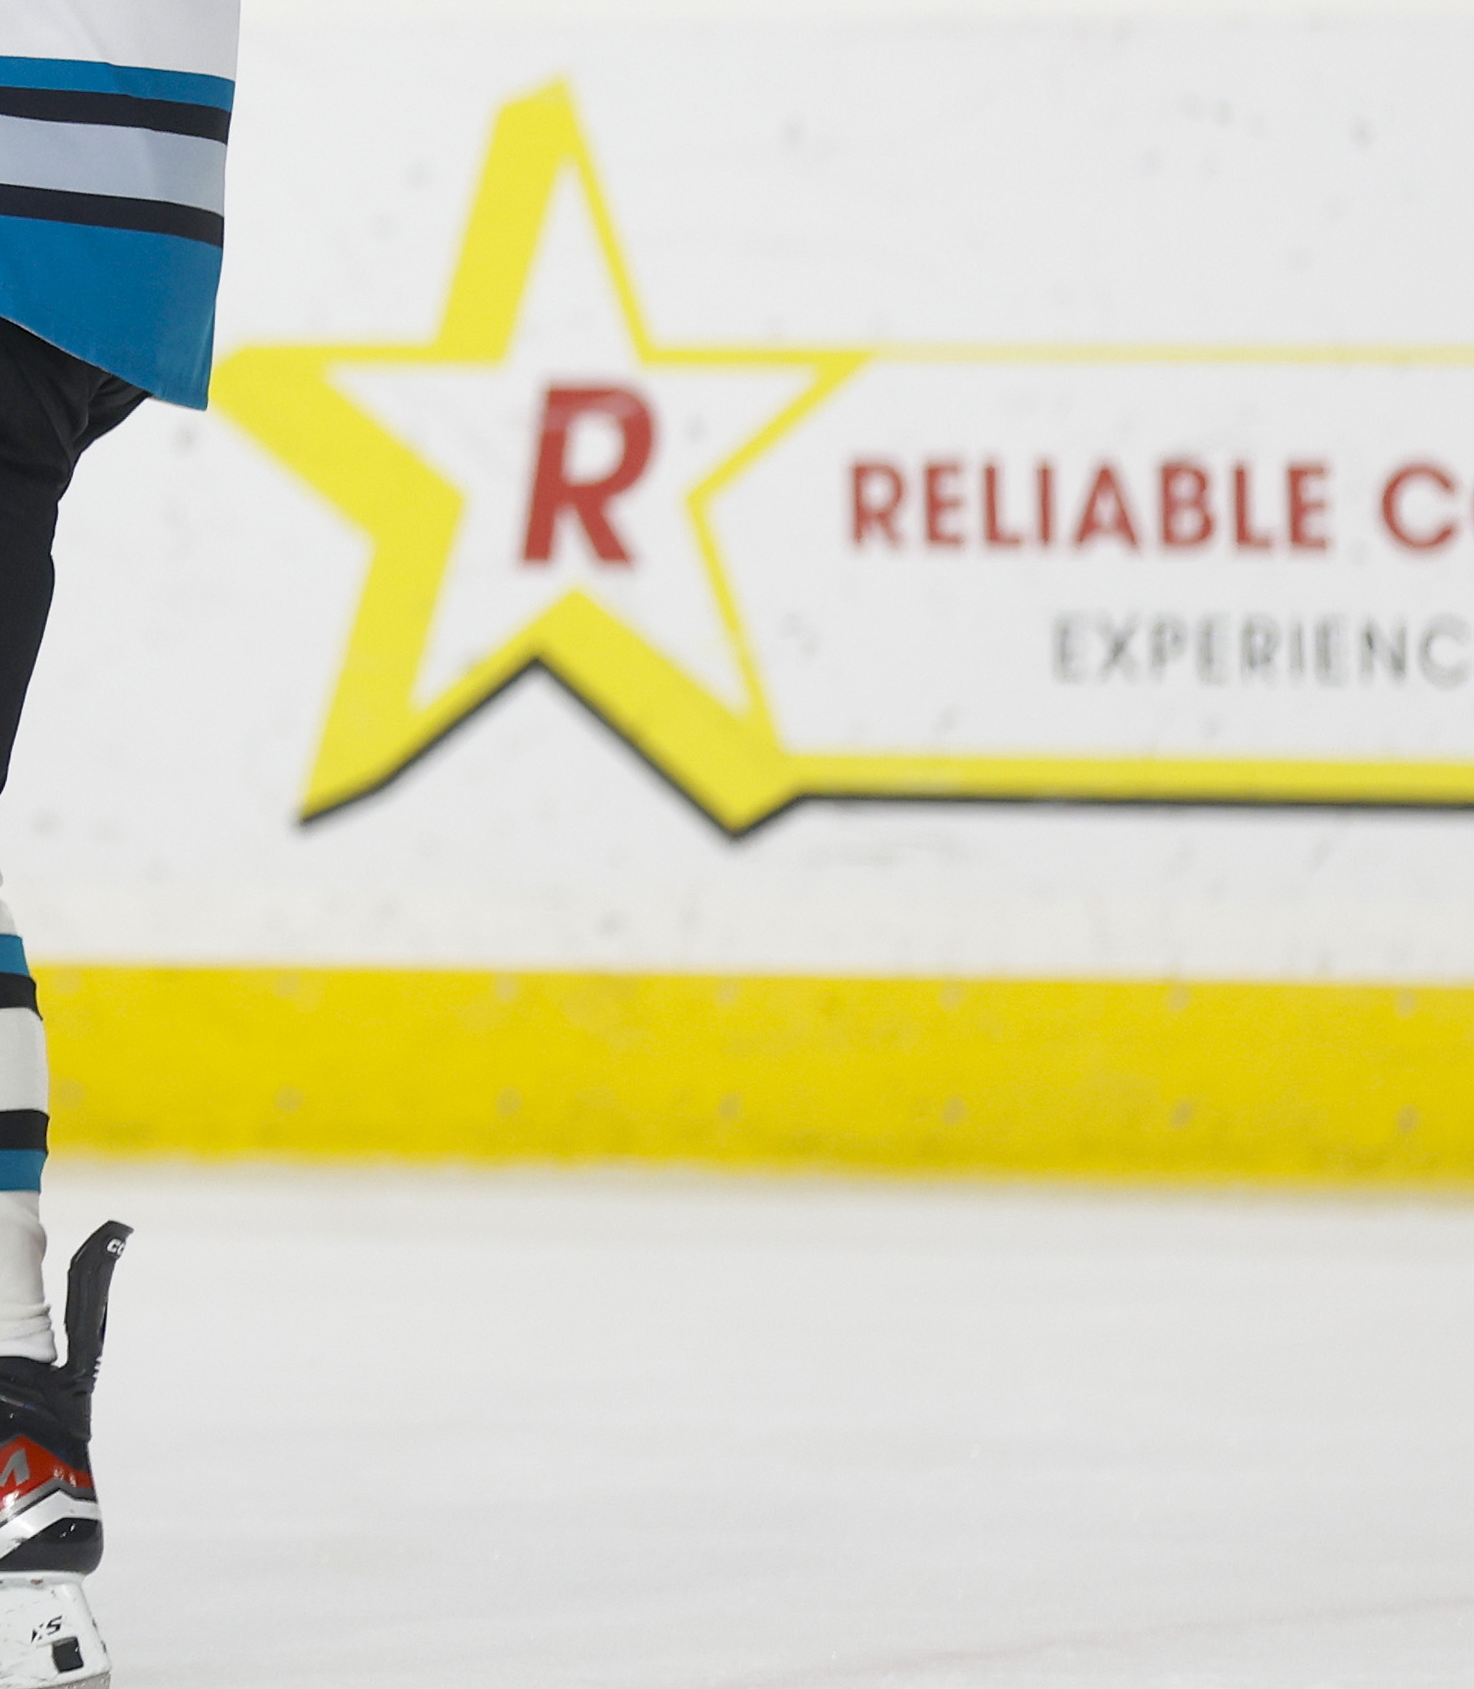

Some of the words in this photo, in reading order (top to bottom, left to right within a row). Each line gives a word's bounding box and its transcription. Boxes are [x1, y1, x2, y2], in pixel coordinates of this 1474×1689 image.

[515, 382, 659, 570] R
[846, 457, 1334, 552] RELIABLE
[1379, 457, 1474, 555] C
